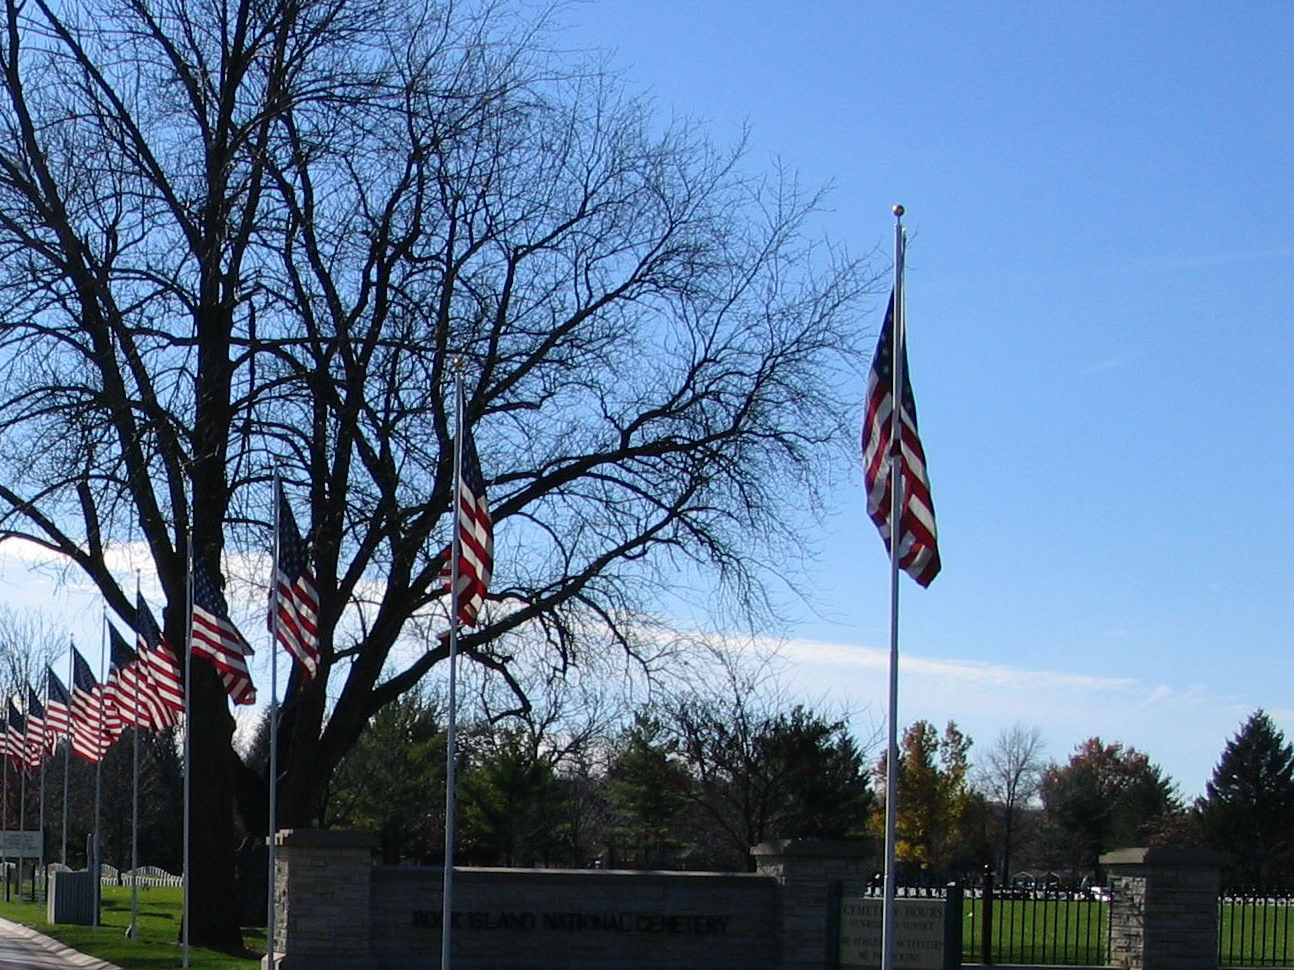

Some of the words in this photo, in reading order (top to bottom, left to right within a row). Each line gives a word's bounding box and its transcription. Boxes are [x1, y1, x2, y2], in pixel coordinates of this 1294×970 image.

[842, 904, 898, 916] CEMETY
[467, 911, 536, 931] ISLAND
[543, 911, 632, 932] NATIONAL
[636, 914, 730, 937] CEMETERY
